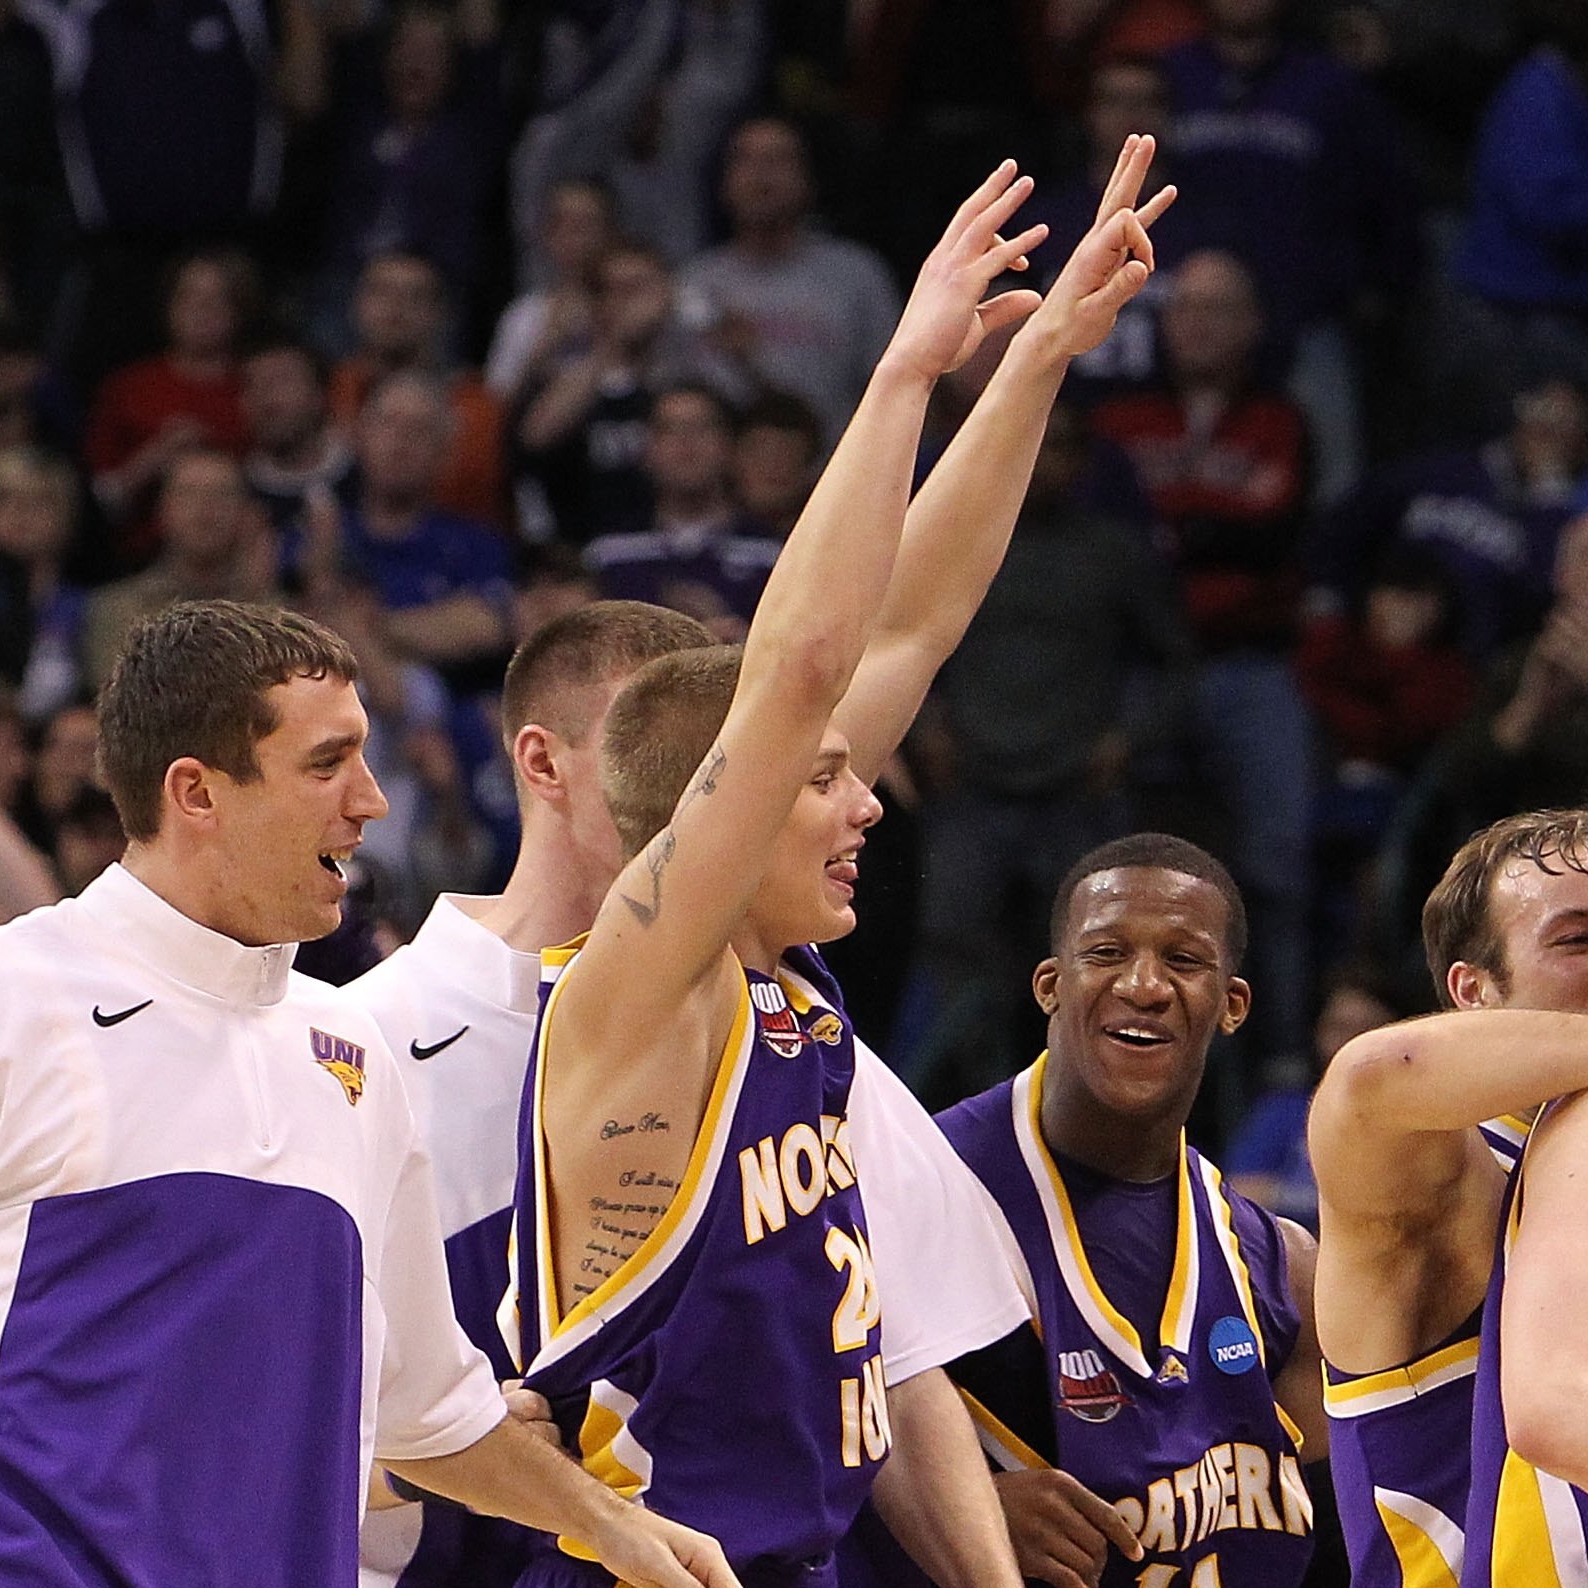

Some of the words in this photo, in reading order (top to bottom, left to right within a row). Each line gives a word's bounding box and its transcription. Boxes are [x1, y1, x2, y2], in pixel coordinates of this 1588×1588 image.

[749, 982, 787, 1014] 100
[309, 1026, 366, 1072] UNI
[1058, 1348, 1105, 1381] 100
[1216, 1342, 1254, 1362] NCAA
